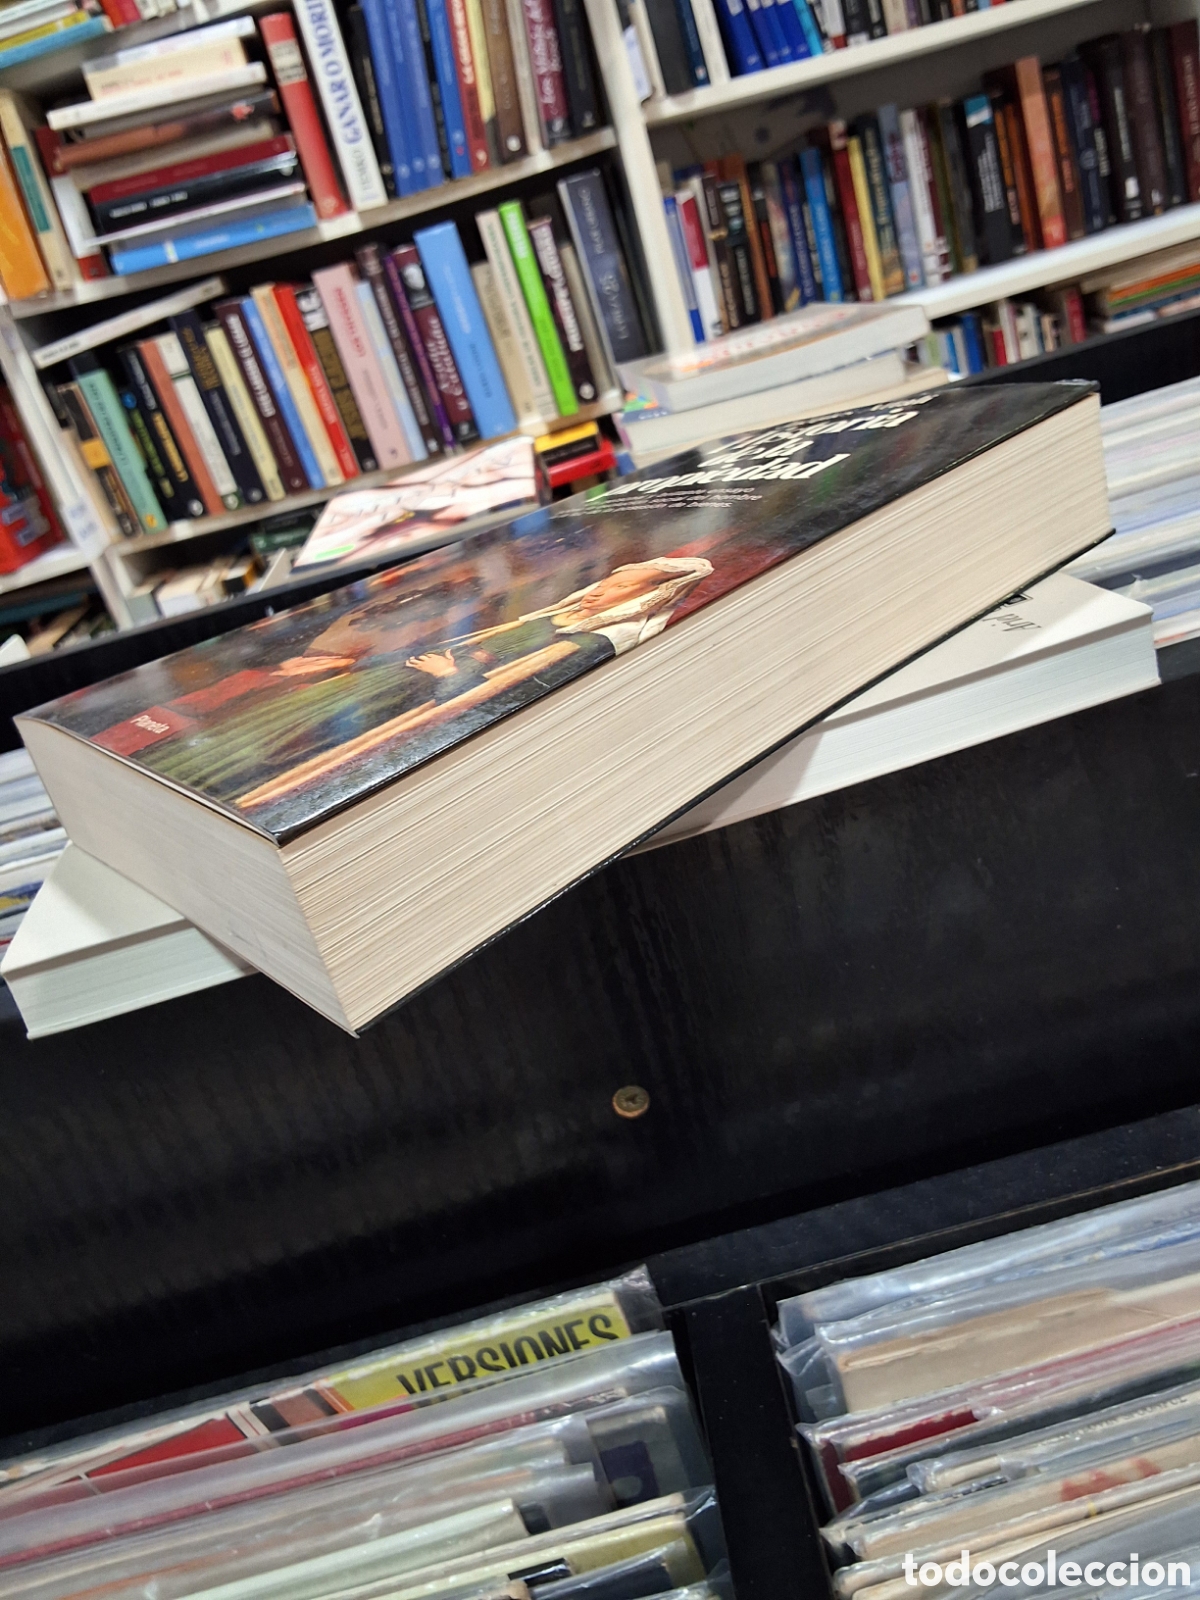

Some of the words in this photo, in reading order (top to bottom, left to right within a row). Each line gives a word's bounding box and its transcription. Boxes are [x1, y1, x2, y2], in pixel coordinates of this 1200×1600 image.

[305, 0, 335, 58] MORI
[329, 79, 362, 145] GANAR
[750, 438, 814, 460] la
[585, 453, 851, 503] propiedad
[130, 714, 170, 735] Planeta
[396, 1314, 619, 1396] VERSIONES
